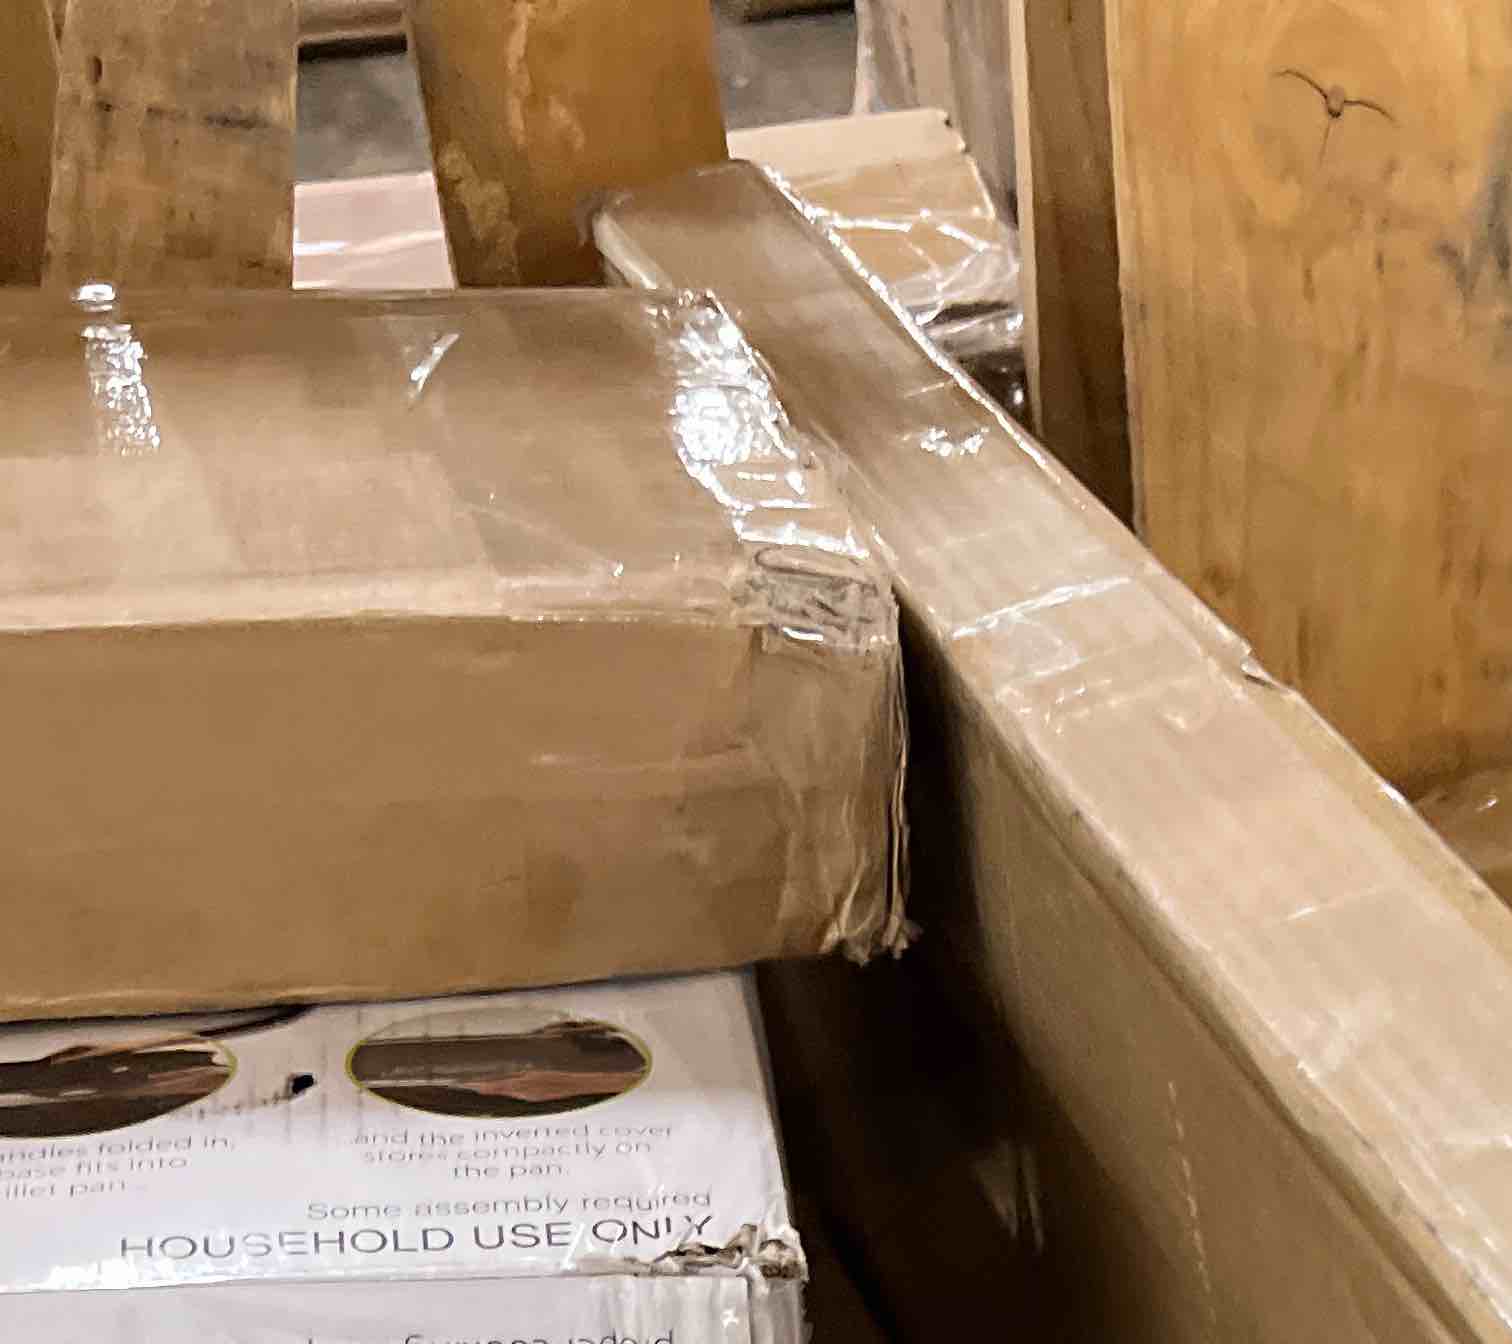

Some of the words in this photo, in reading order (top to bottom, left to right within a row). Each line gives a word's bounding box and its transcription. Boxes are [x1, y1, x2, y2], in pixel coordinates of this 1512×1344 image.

[456, 1140, 607, 1162] compactly
[452, 1163, 501, 1179] the
[306, 1200, 402, 1221] Some
[414, 1194, 569, 1217] assembly
[582, 1189, 712, 1214] required
[119, 1226, 456, 1260] HOUSEHOLD
[473, 1219, 572, 1250] USE
